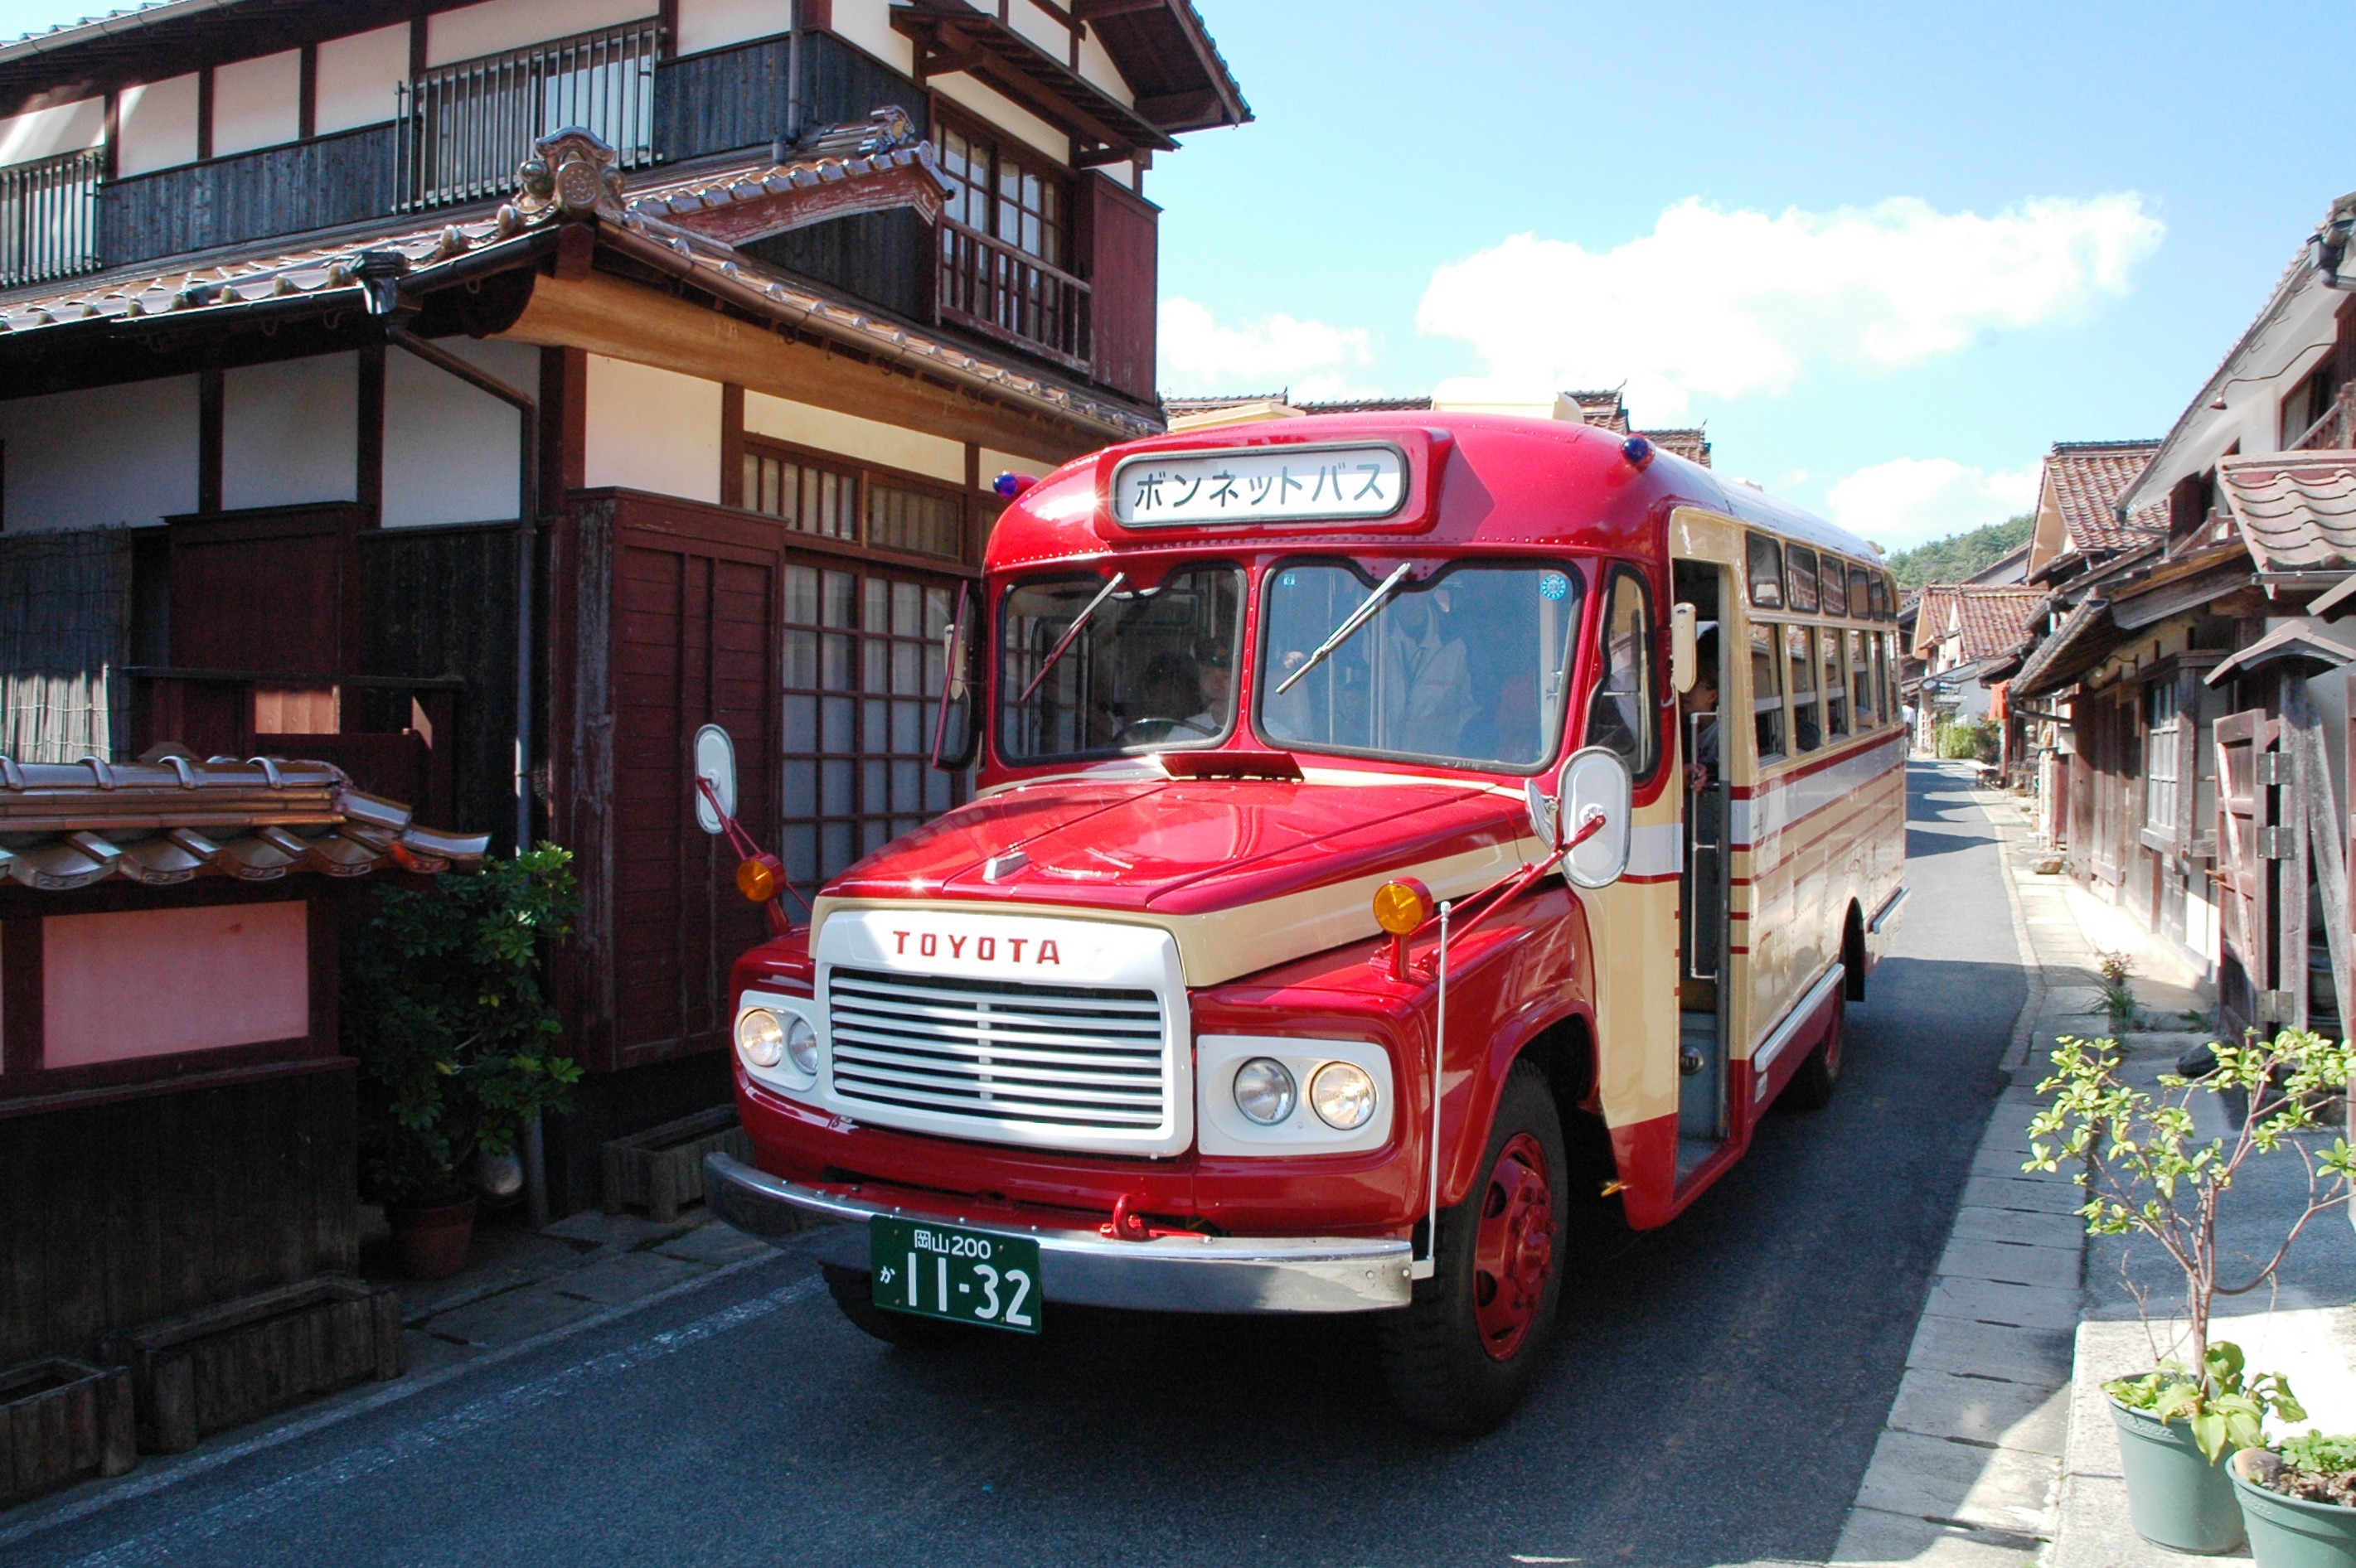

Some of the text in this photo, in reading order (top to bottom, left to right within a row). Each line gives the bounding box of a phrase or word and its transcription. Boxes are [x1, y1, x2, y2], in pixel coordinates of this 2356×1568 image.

[1134, 462, 1385, 511] ボンネットバス
[893, 931, 1060, 965] TOYOTA
[880, 1252, 1032, 1327] か 11-32
